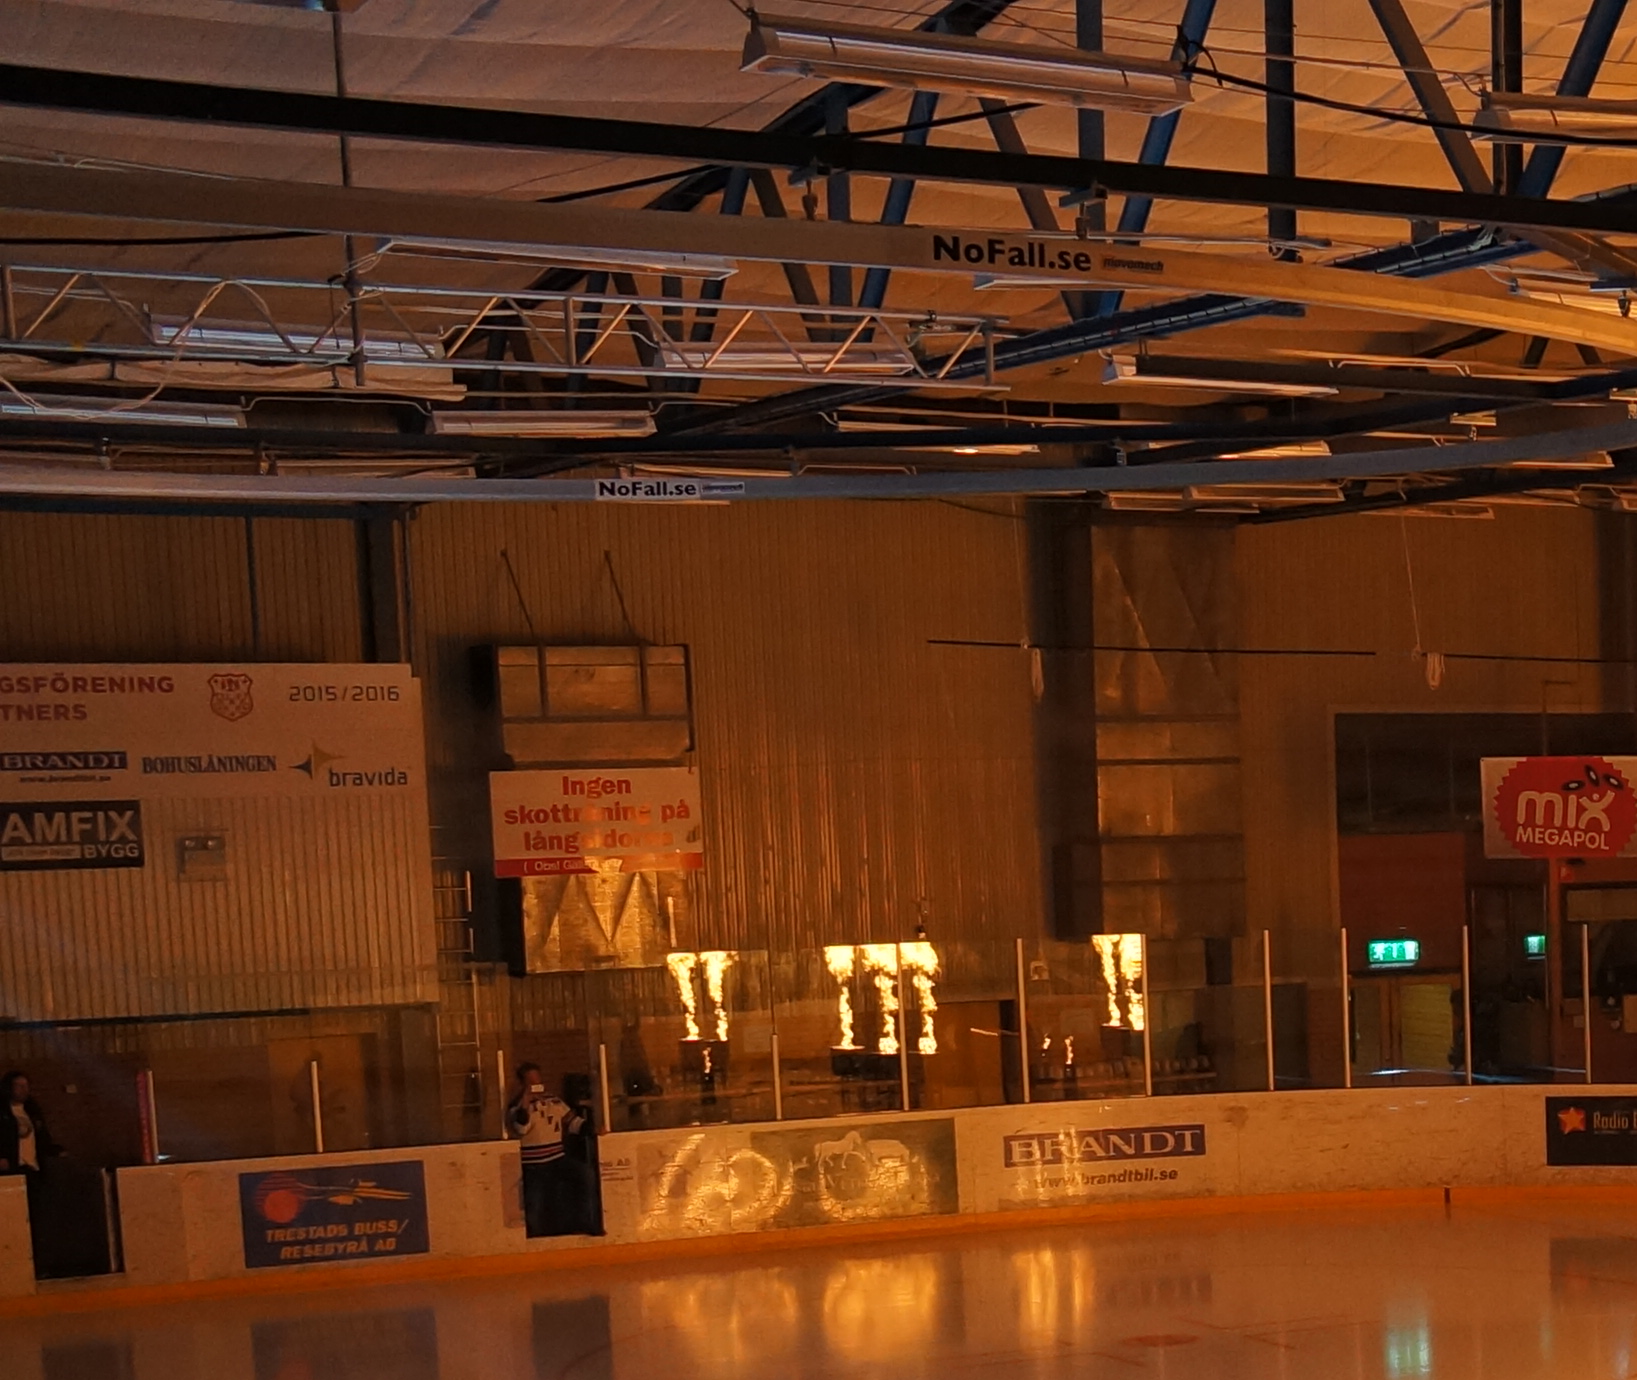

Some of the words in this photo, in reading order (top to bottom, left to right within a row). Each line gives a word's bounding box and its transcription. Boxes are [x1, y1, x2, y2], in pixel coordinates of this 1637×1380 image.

[933, 235, 1092, 272] NoFall.se
[599, 481, 697, 497] NoFall.se
[0, 672, 175, 693] GSFÖRENING
[289, 684, 400, 702] 2015/2016
[0, 704, 88, 721] TNERS
[3, 754, 123, 769] BRANDT
[329, 767, 408, 787] bravida
[562, 776, 632, 799] Ingen
[660, 799, 690, 823] på
[1516, 790, 1615, 831] mix
[1, 810, 138, 844] AMFIX
[1516, 825, 1609, 850] MEGAPOL
[84, 843, 139, 859] BYGG
[1593, 1110, 1629, 1129] Radio
[1009, 1130, 1201, 1163] BRANDT
[266, 1224, 348, 1242] TRESTADS
